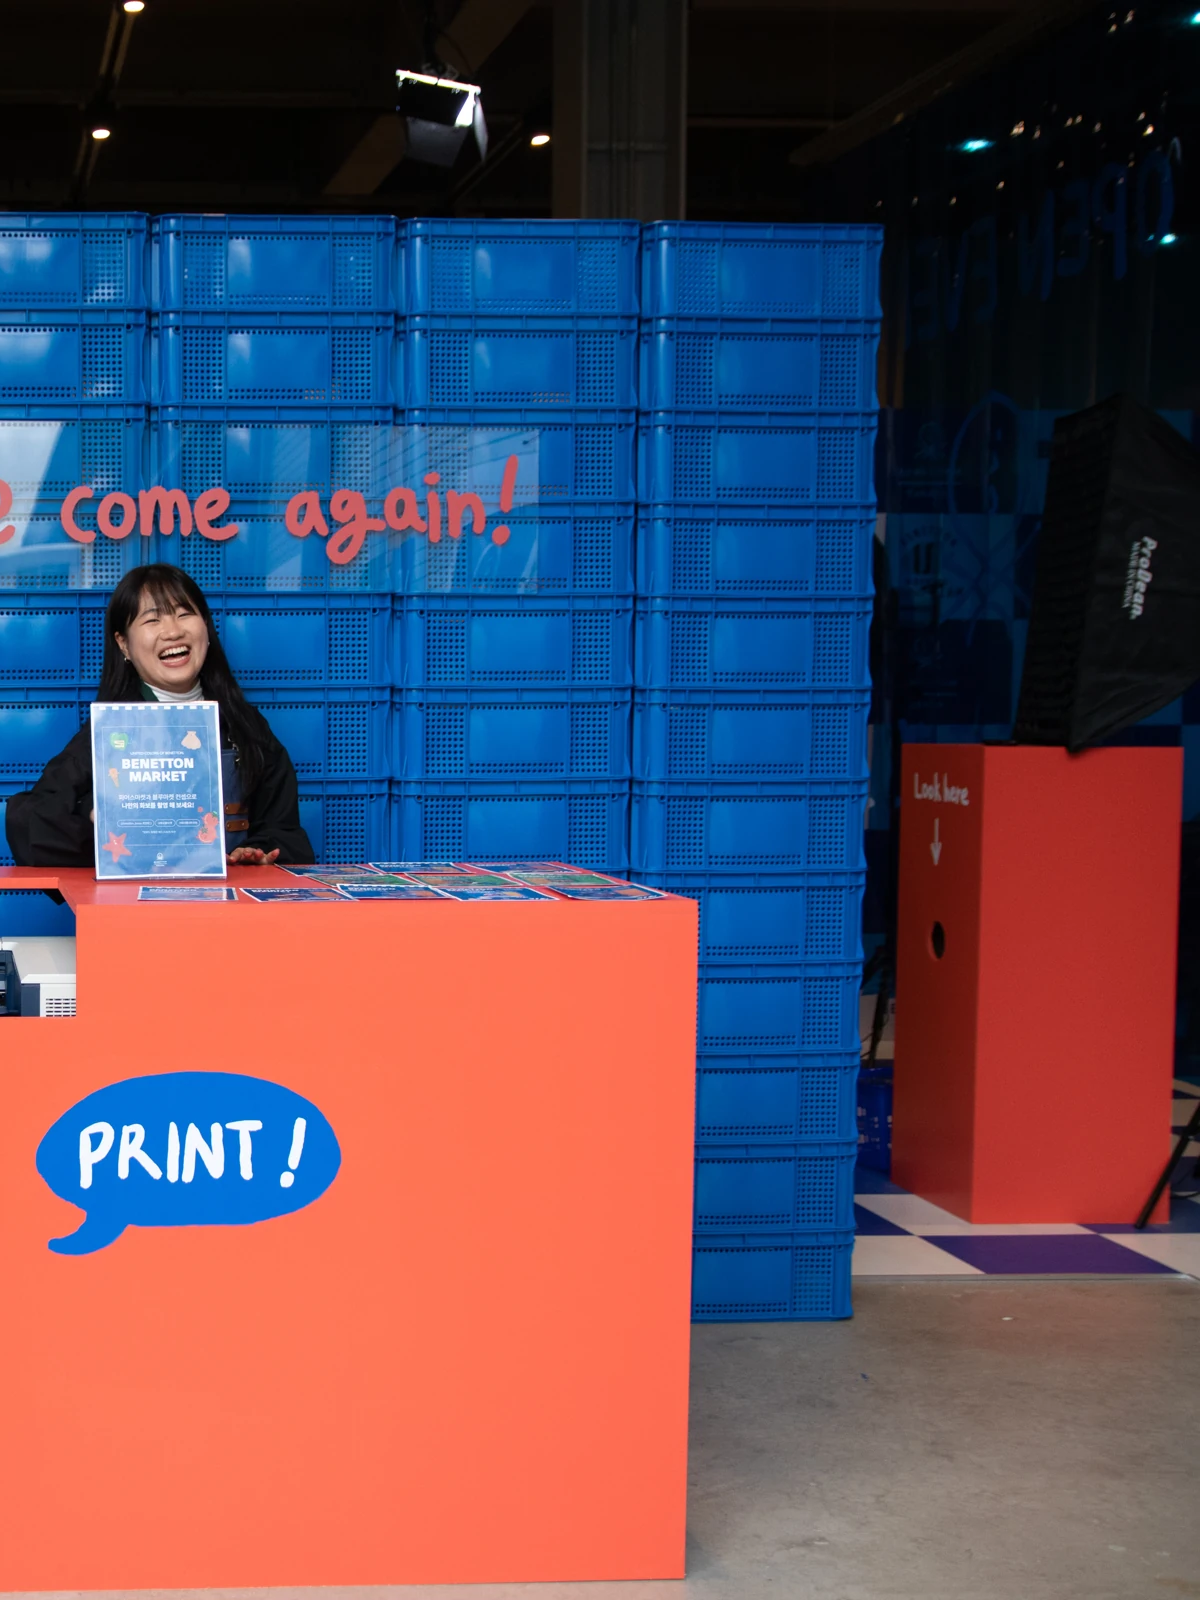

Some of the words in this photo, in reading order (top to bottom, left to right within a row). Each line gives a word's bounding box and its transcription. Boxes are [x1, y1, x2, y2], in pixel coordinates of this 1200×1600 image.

[60, 485, 239, 543] come
[285, 454, 518, 564] again!
[121, 758, 194, 769] BENETTON
[129, 771, 188, 782] MARKET
[913, 771, 942, 802] Look
[943, 772, 970, 806] here
[79, 1119, 263, 1190] PRINT
